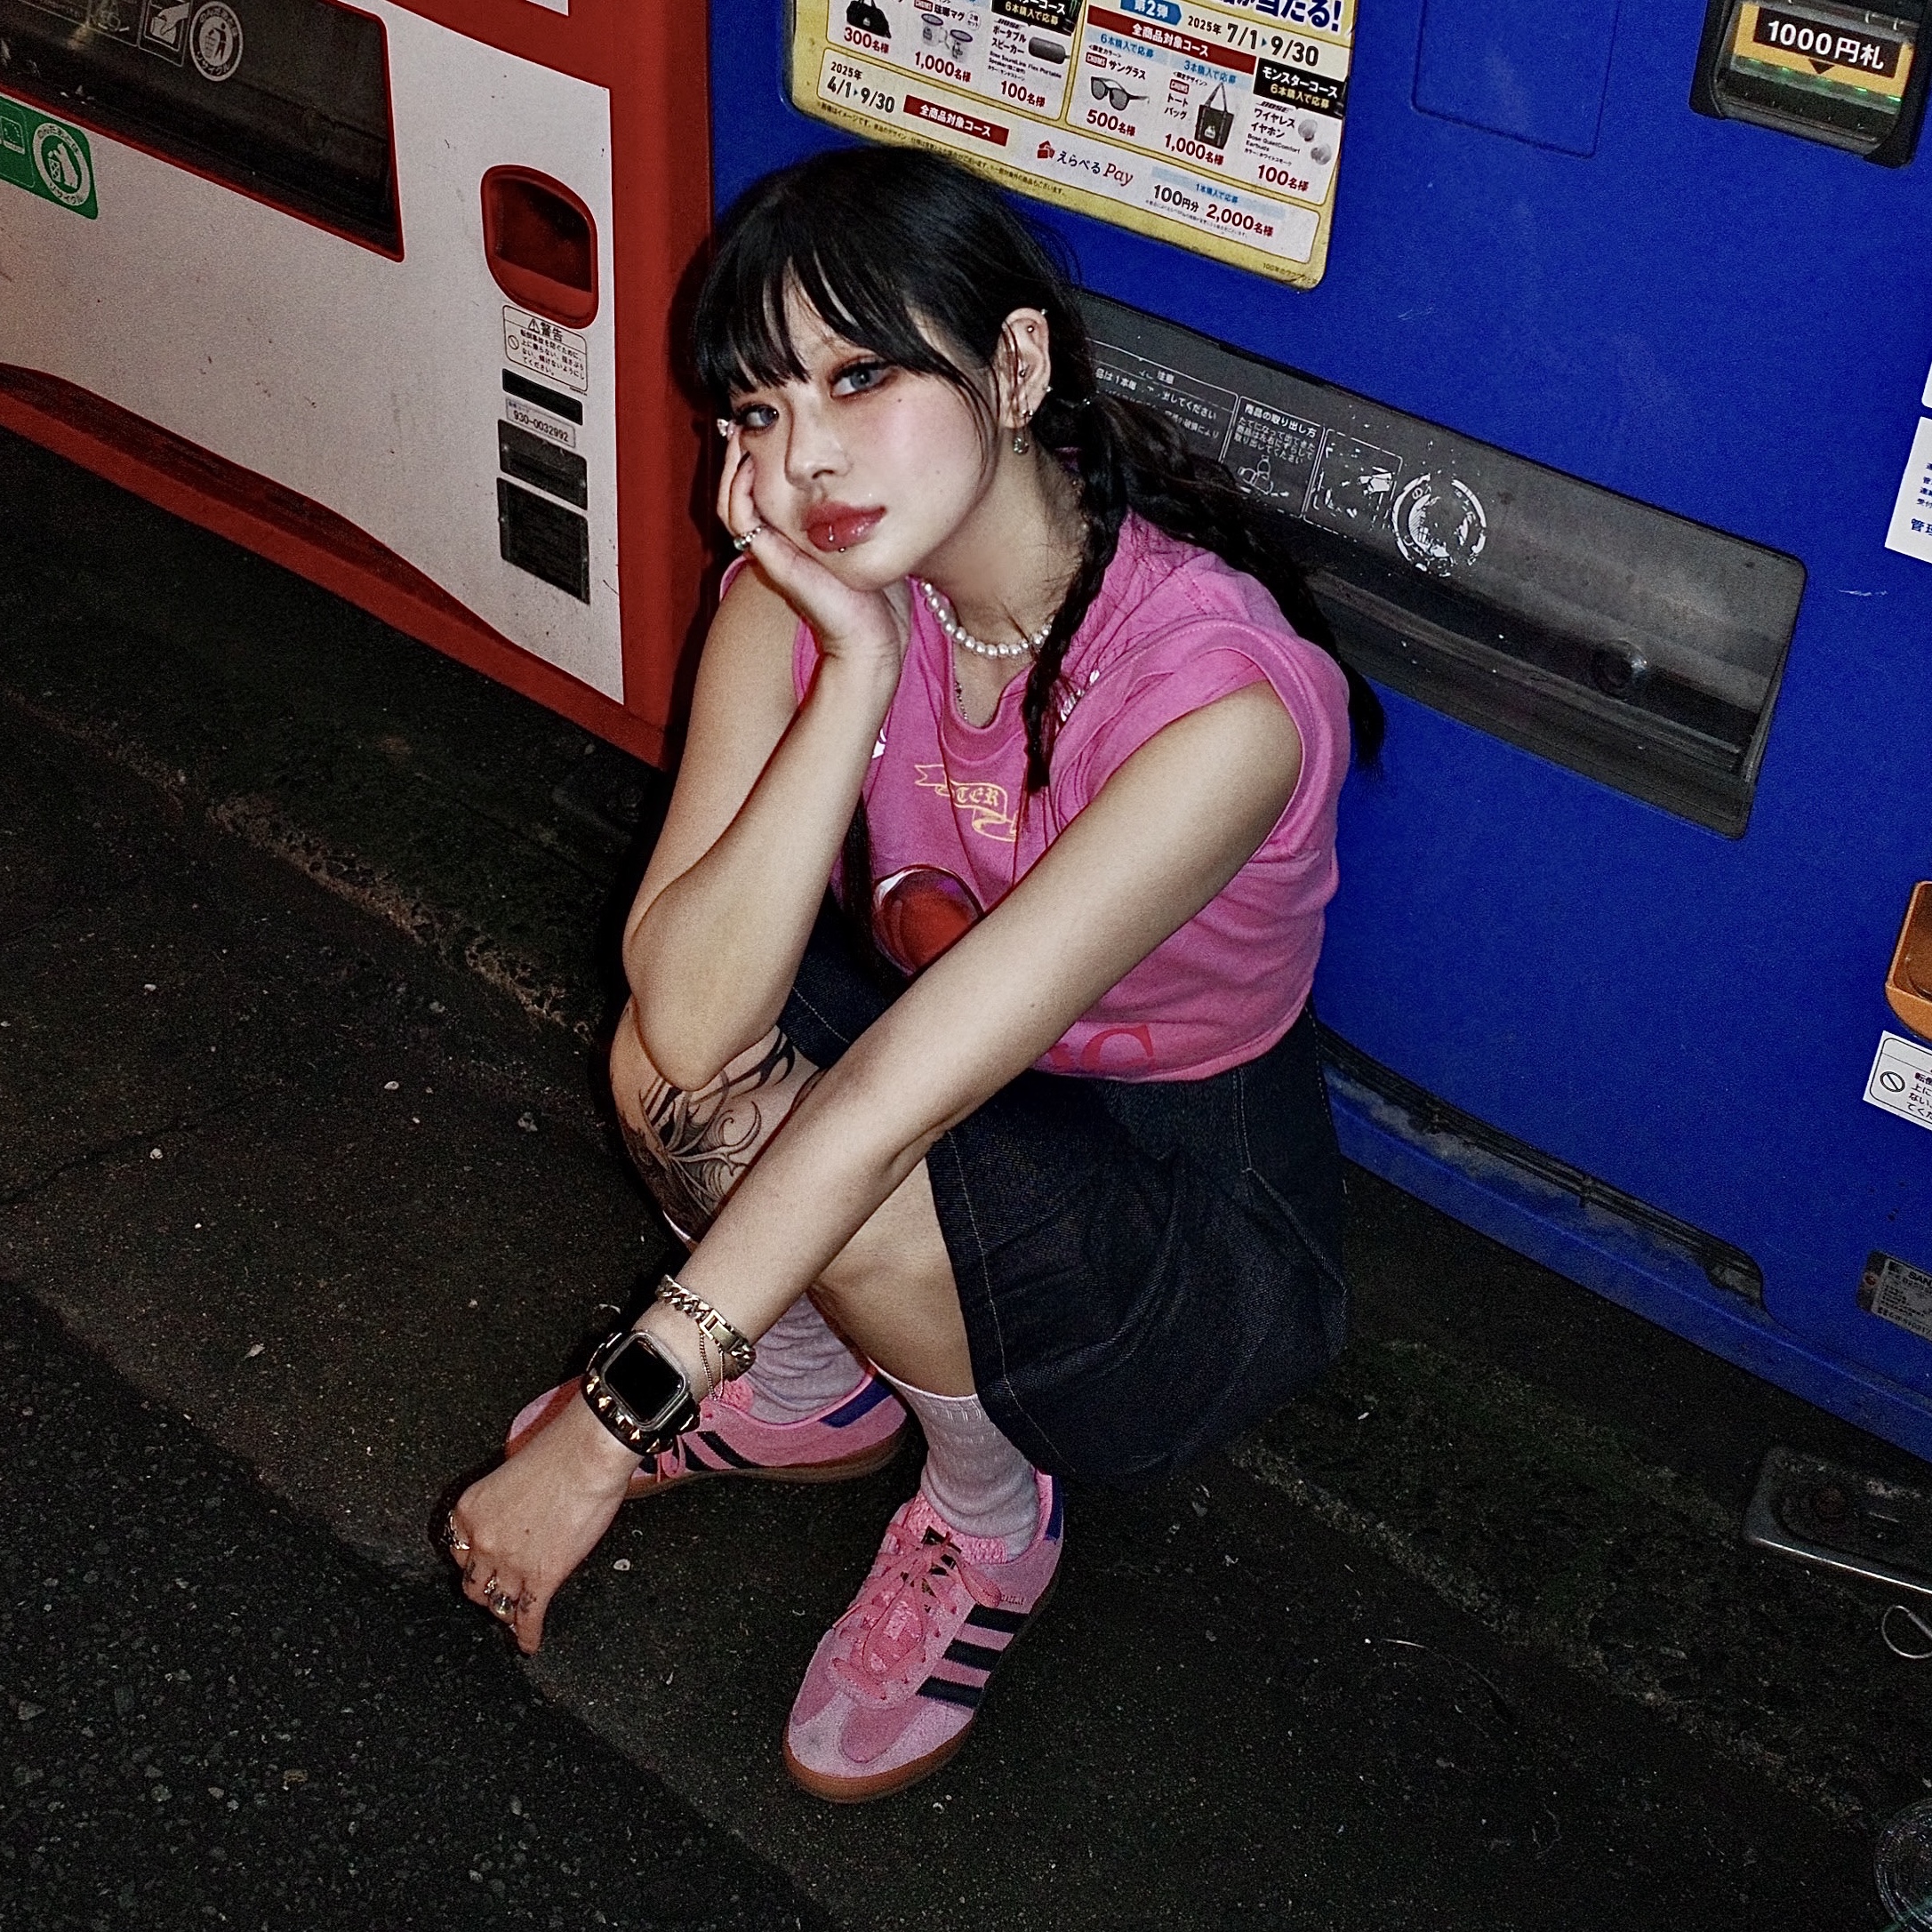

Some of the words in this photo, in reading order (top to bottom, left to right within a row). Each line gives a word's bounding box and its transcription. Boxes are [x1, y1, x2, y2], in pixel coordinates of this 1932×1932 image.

[1005, 2, 1059, 26] 6本購入で応募
[844, 27, 889, 54] 300名様
[991, 37, 1024, 54] スピーカー
[1100, 33, 1154, 58] 6本購入で応募
[1131, 22, 1209, 58] 全商品対象コース
[1188, 15, 1223, 36] 2025年
[1227, 22, 1258, 50] 7/1
[1271, 36, 1319, 67] 9/30
[1768, 20, 1884, 70] 1000円札
[830, 61, 863, 81] 2025年
[915, 51, 971, 83] 1,000名様
[1086, 54, 1106, 68] CHUMS
[1108, 60, 1146, 80] サングラス
[1183, 60, 1237, 84] 3本購入で応募
[827, 76, 852, 99] 4/1
[861, 87, 895, 113] 9/30
[1000, 80, 1046, 108] 100名様
[1263, 66, 1338, 99] モンスターコース
[1271, 84, 1330, 109] 6本購入で応募
[1164, 107, 1187, 120] バッグ
[1167, 93, 1189, 107] トート
[919, 104, 991, 138] 全商品対象コース
[1086, 109, 1136, 137] 500名様
[1251, 122, 1285, 139] イヤホン
[1254, 108, 1295, 129] ワイヤレス
[1165, 133, 1224, 166] 1,000名様
[1057, 149, 1134, 186] えらべるPay
[1258, 164, 1310, 192] 100名様
[1153, 184, 1199, 212] 100円分
[1206, 204, 1274, 237] 2,000名様
[541, 322, 563, 343] 警告
[513, 409, 569, 443] 930-0032992
[1245, 403, 1318, 438] 商品の取り出し方
[1911, 1083, 1932, 1097] 上に
